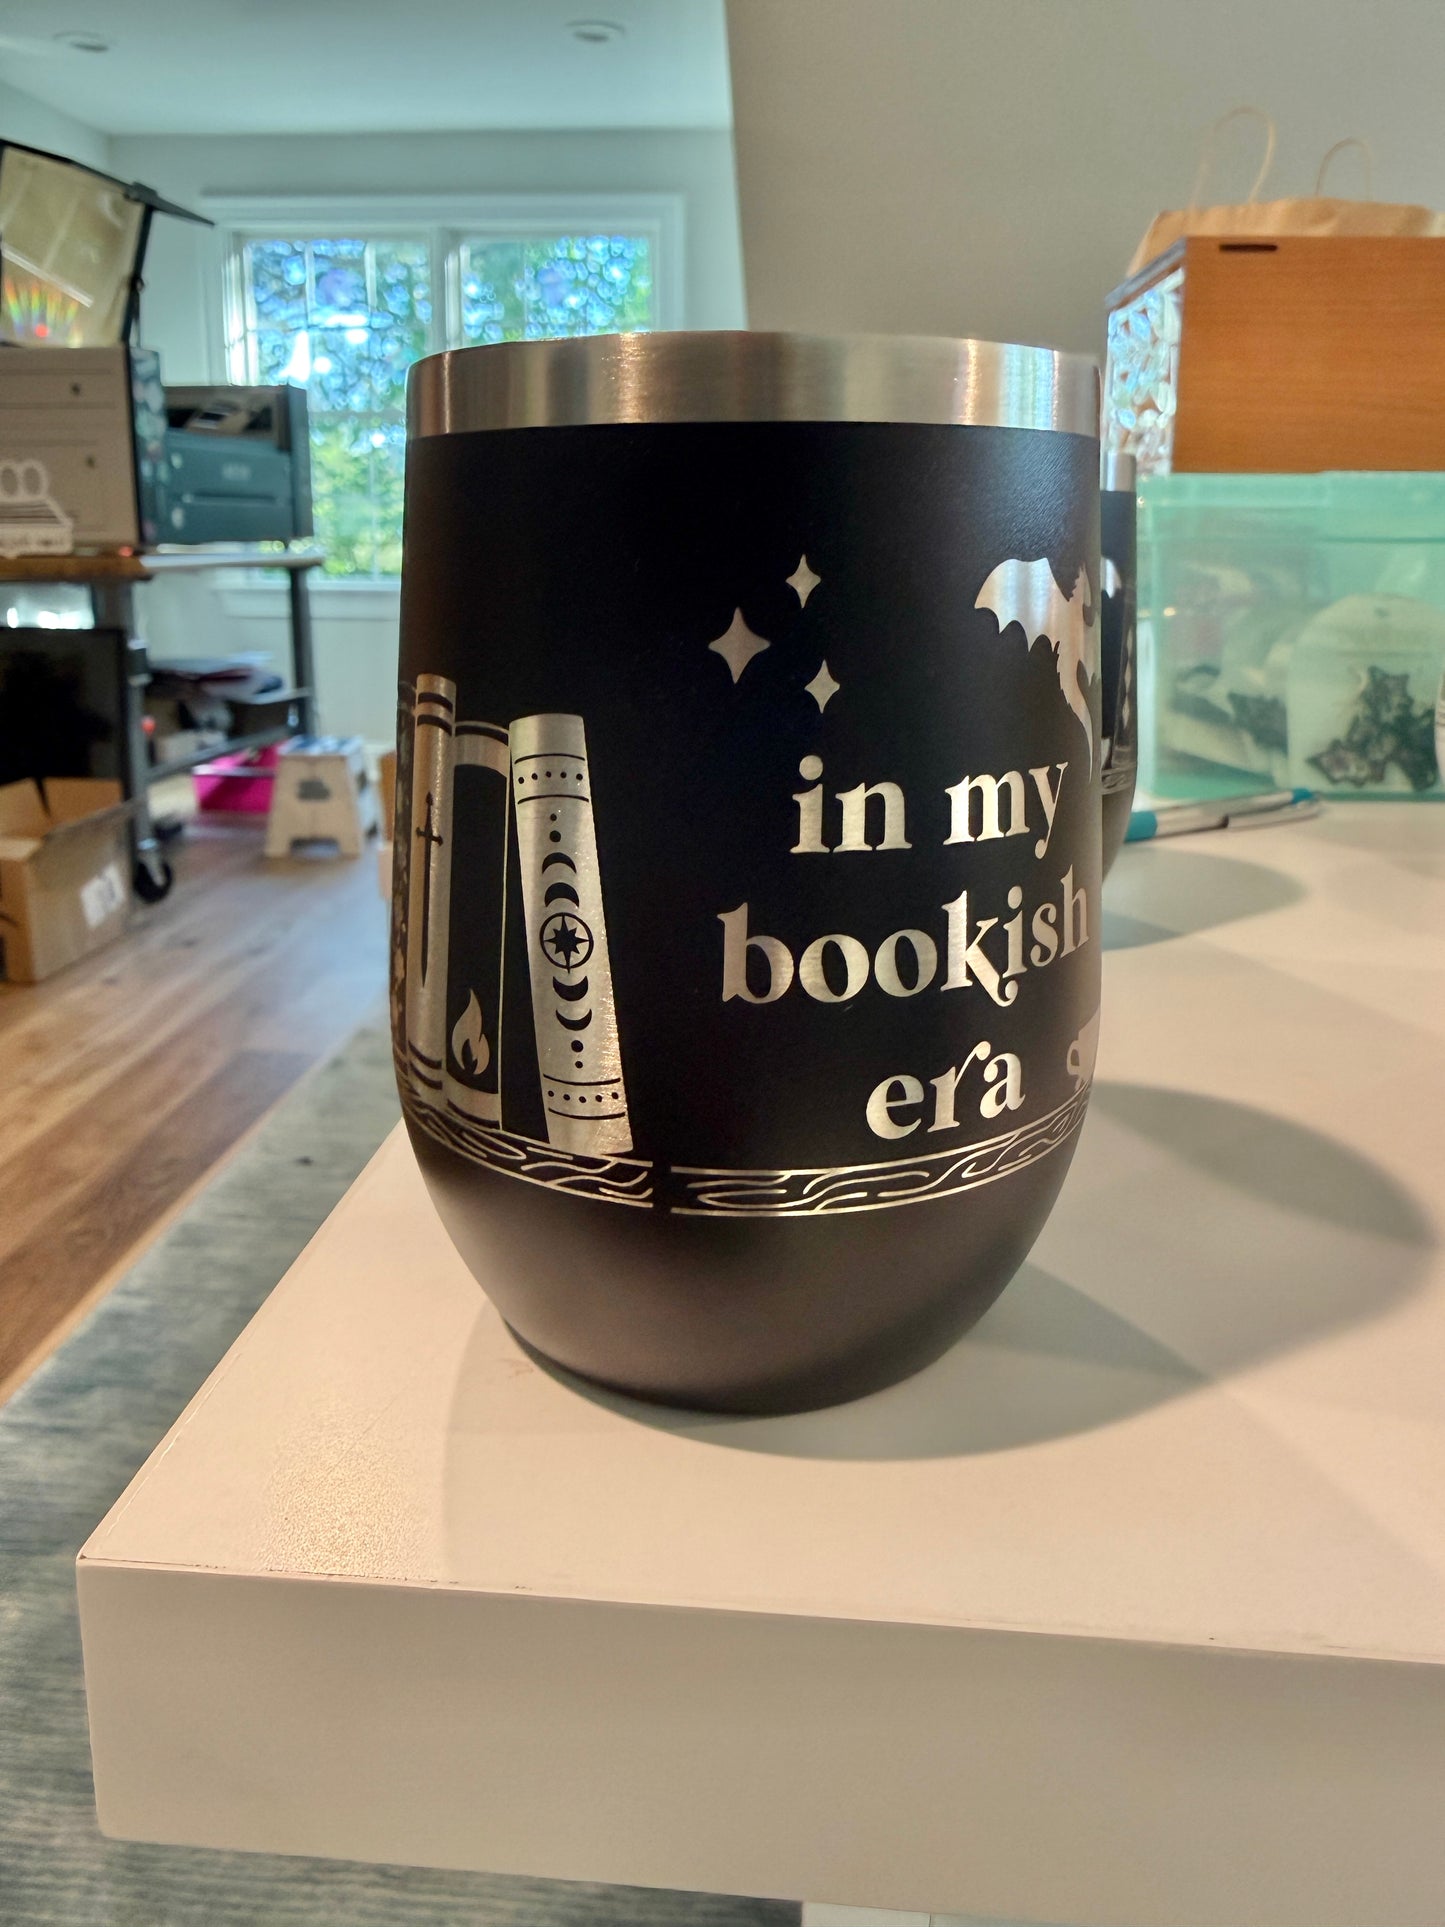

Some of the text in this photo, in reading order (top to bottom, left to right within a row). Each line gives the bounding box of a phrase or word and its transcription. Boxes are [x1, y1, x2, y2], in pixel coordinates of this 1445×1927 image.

[790, 756, 1069, 860] in my
[717, 865, 1089, 1008] bookish
[866, 1041, 1026, 1140] era
